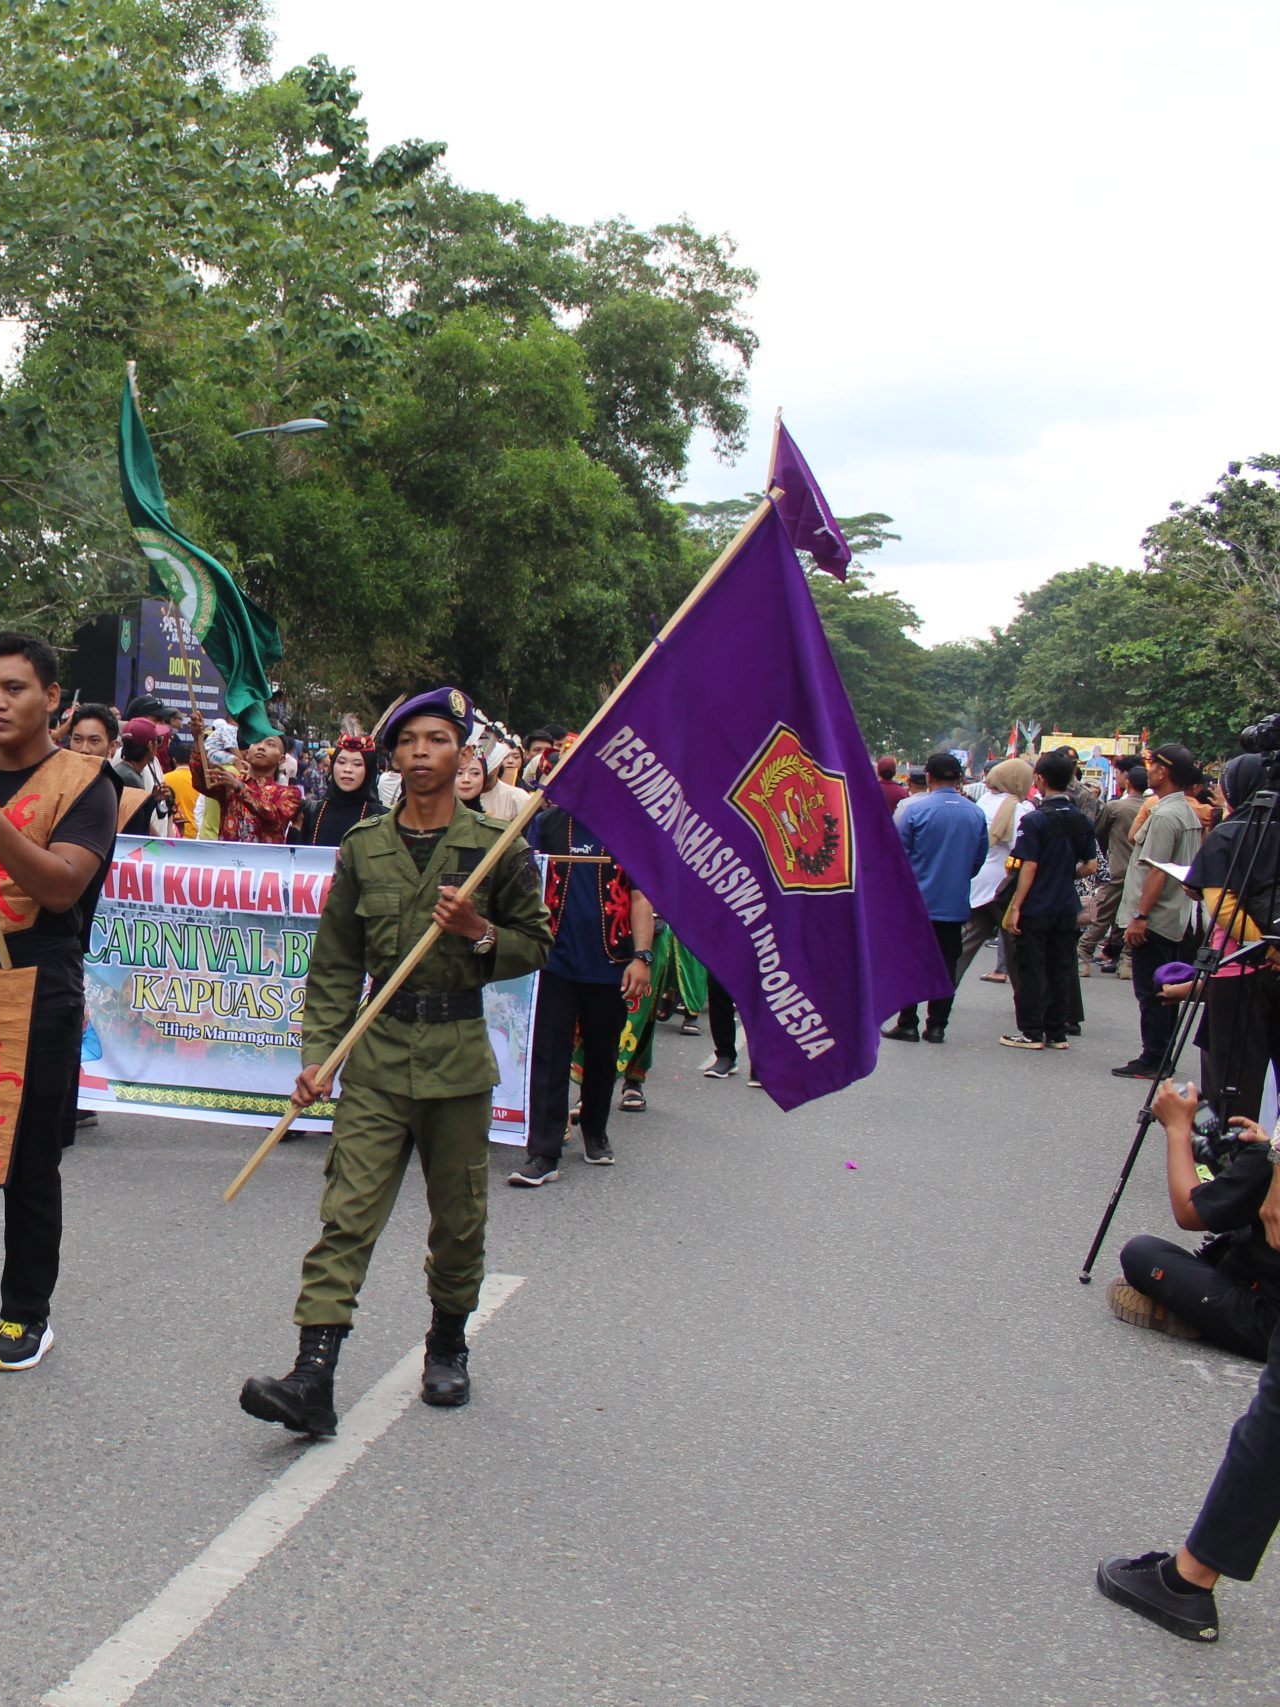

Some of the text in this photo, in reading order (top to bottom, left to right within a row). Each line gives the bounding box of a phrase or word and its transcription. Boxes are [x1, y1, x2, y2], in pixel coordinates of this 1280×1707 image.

[104, 861, 154, 903] TAI
[164, 865, 282, 913] KUALA
[596, 725, 683, 832] RESIMEN
[750, 922, 836, 1061] INDONESIA
[83, 917, 274, 976] CARNIVAL
[132, 974, 283, 1020] KAPUAS
[204, 1025, 283, 1047] Mamangun
